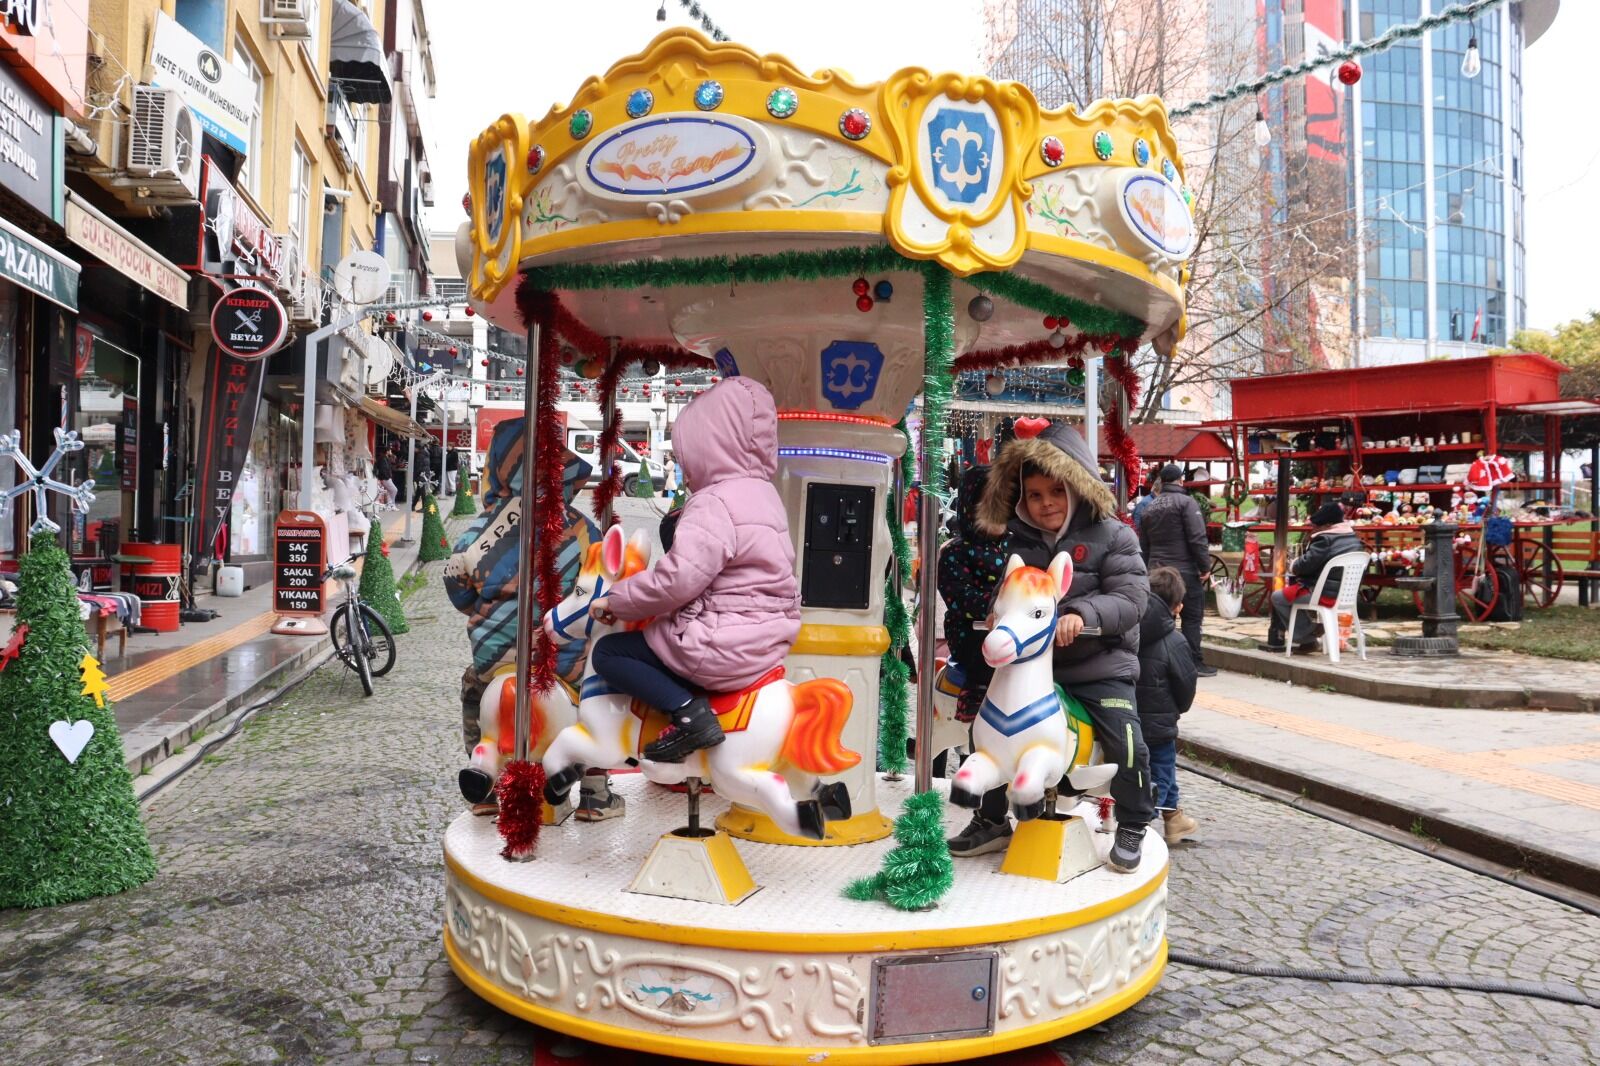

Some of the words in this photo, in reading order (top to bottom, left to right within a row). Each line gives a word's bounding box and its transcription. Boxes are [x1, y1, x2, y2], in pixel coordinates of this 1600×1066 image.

[155, 52, 177, 76] METE
[178, 67, 208, 96] YILDIRIM
[226, 298, 270, 308] KIRMIZI
[230, 333, 263, 342] BEYAZ
[289, 543, 309, 554] SAÇ
[289, 554, 307, 563] 350
[283, 568, 314, 577] SAKAL
[290, 579, 308, 587] 200
[279, 591, 318, 600] YIKAMA
[290, 601, 308, 610] 150
